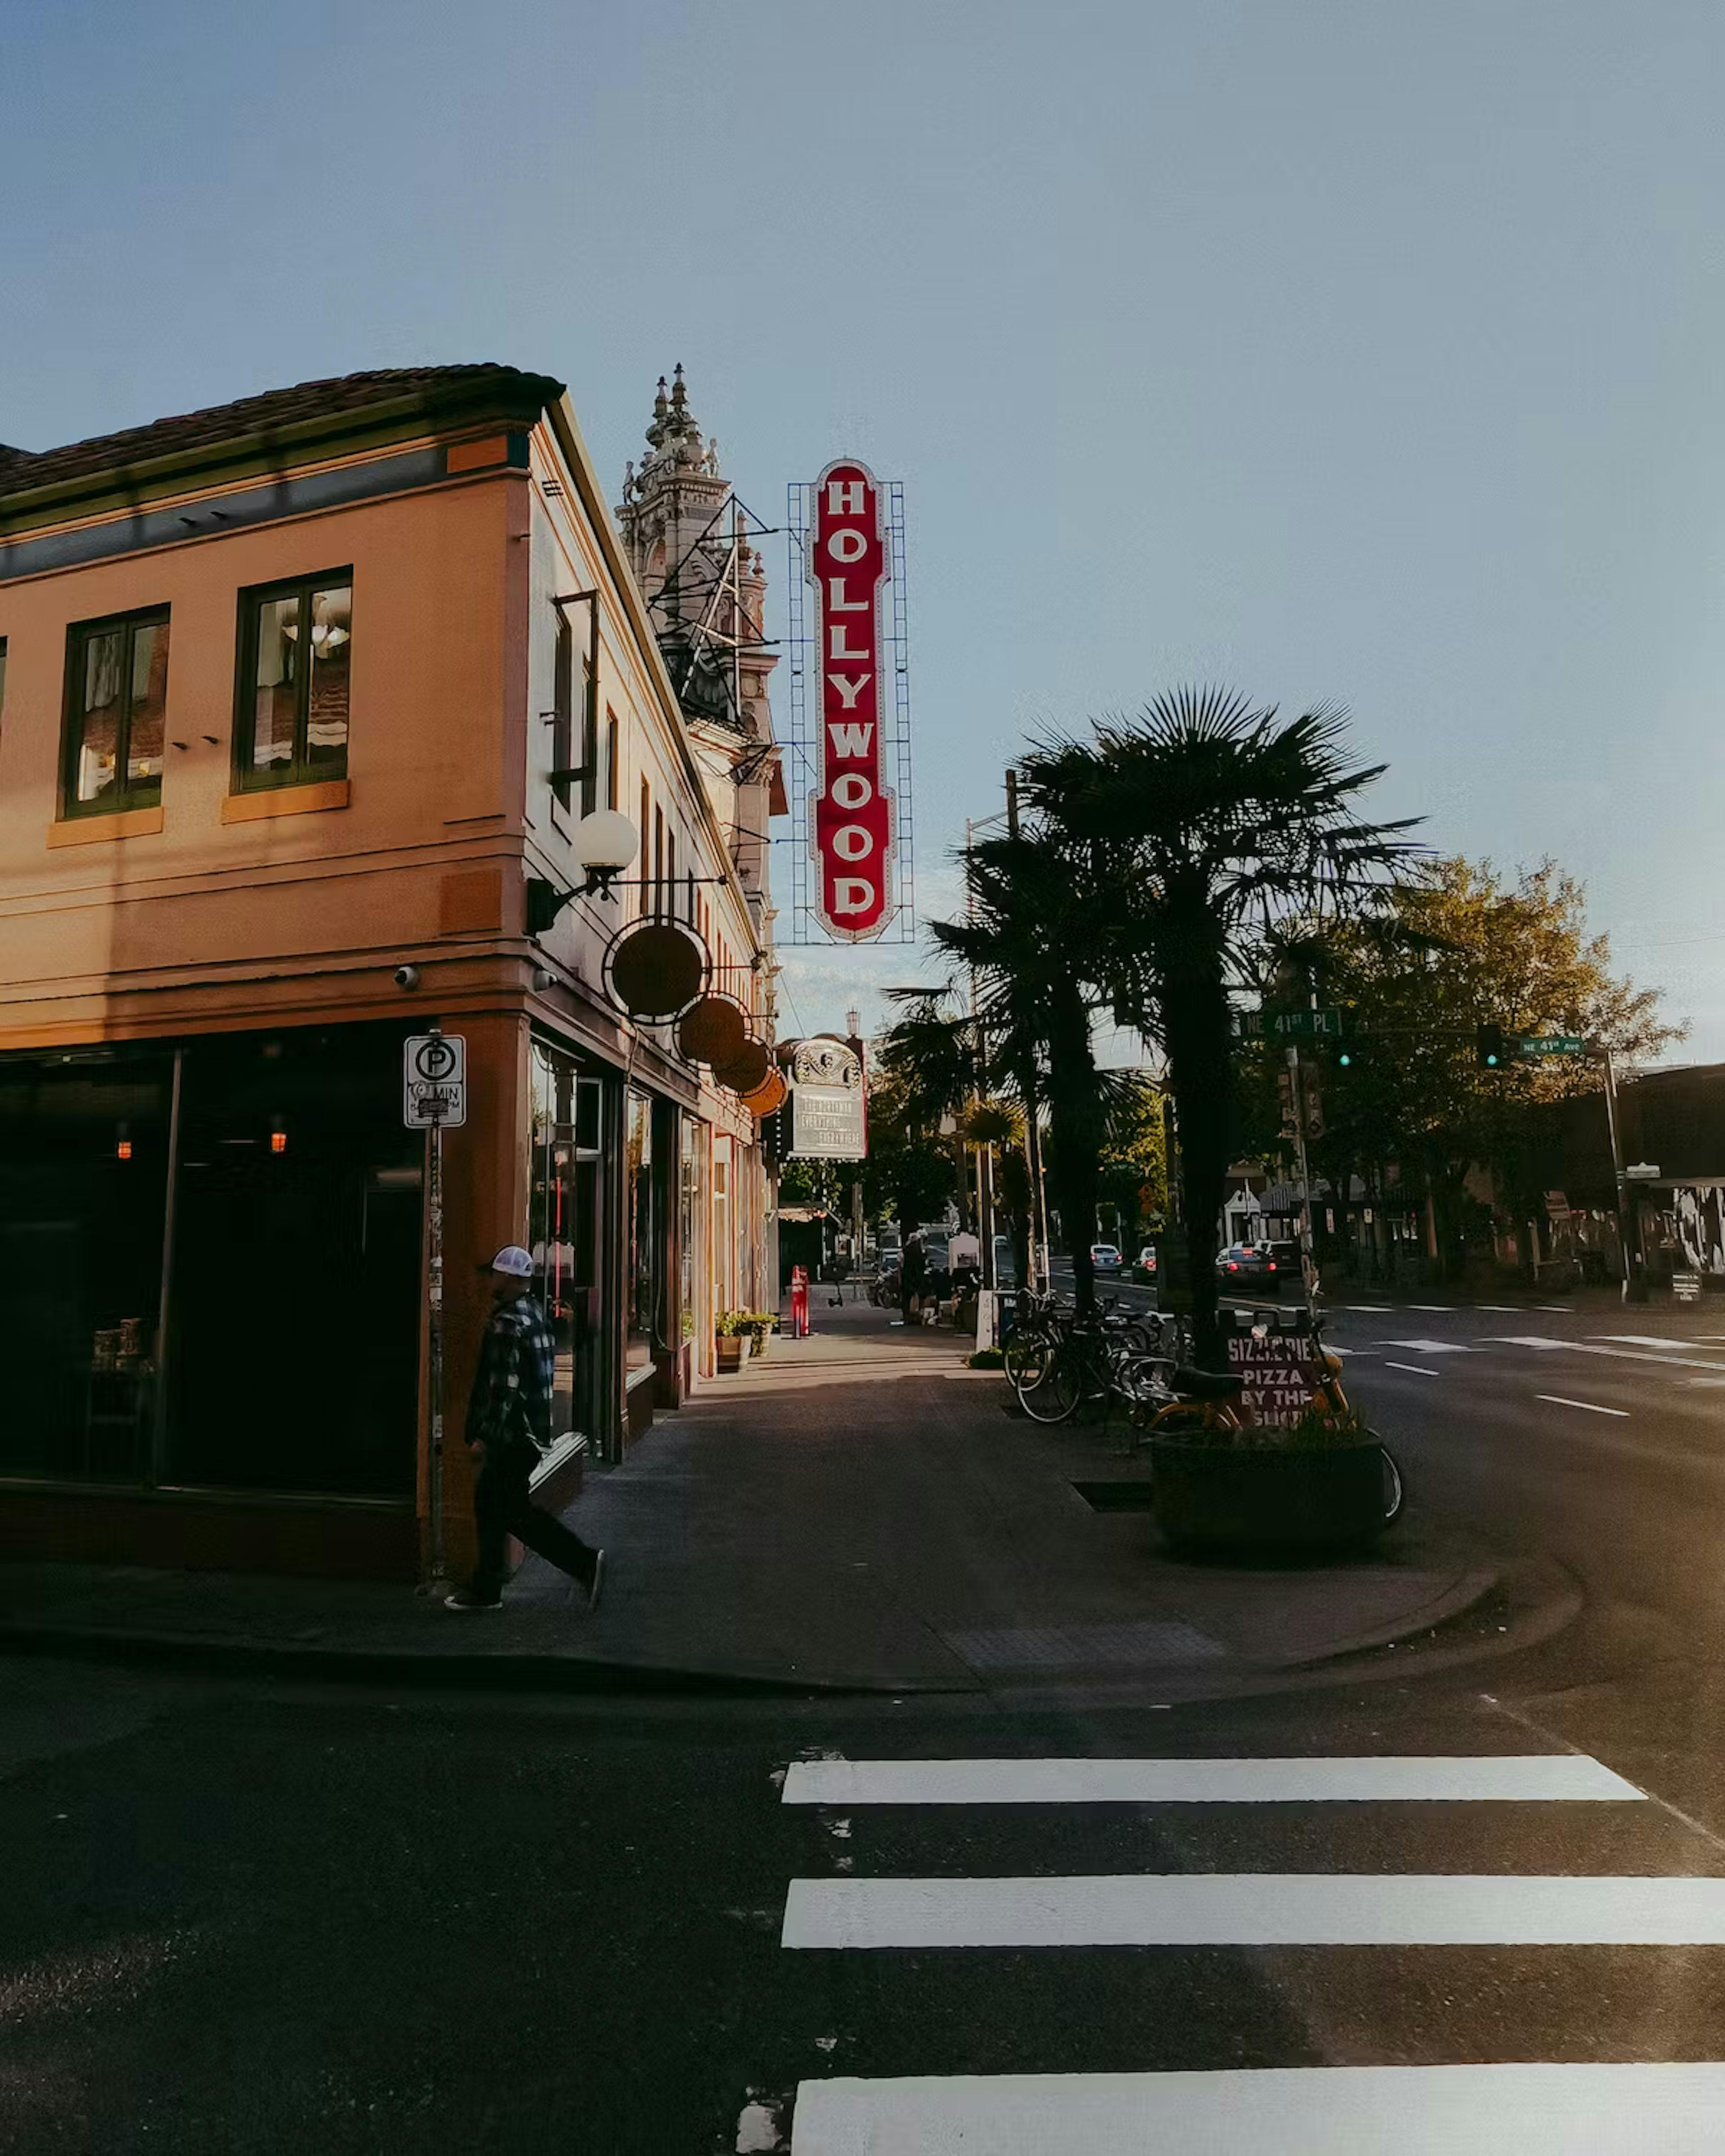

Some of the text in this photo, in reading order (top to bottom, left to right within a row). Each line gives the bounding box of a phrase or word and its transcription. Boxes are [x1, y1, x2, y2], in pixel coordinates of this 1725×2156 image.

[827, 481, 875, 915] HOLLYWOOD
[1247, 1013, 1331, 1034] NE 41ST PL
[1523, 1043, 1535, 1051] NE
[1285, 1338, 1312, 1362] PIE
[1243, 1370, 1304, 1385] PIZZA
[1241, 1391, 1265, 1405] BY
